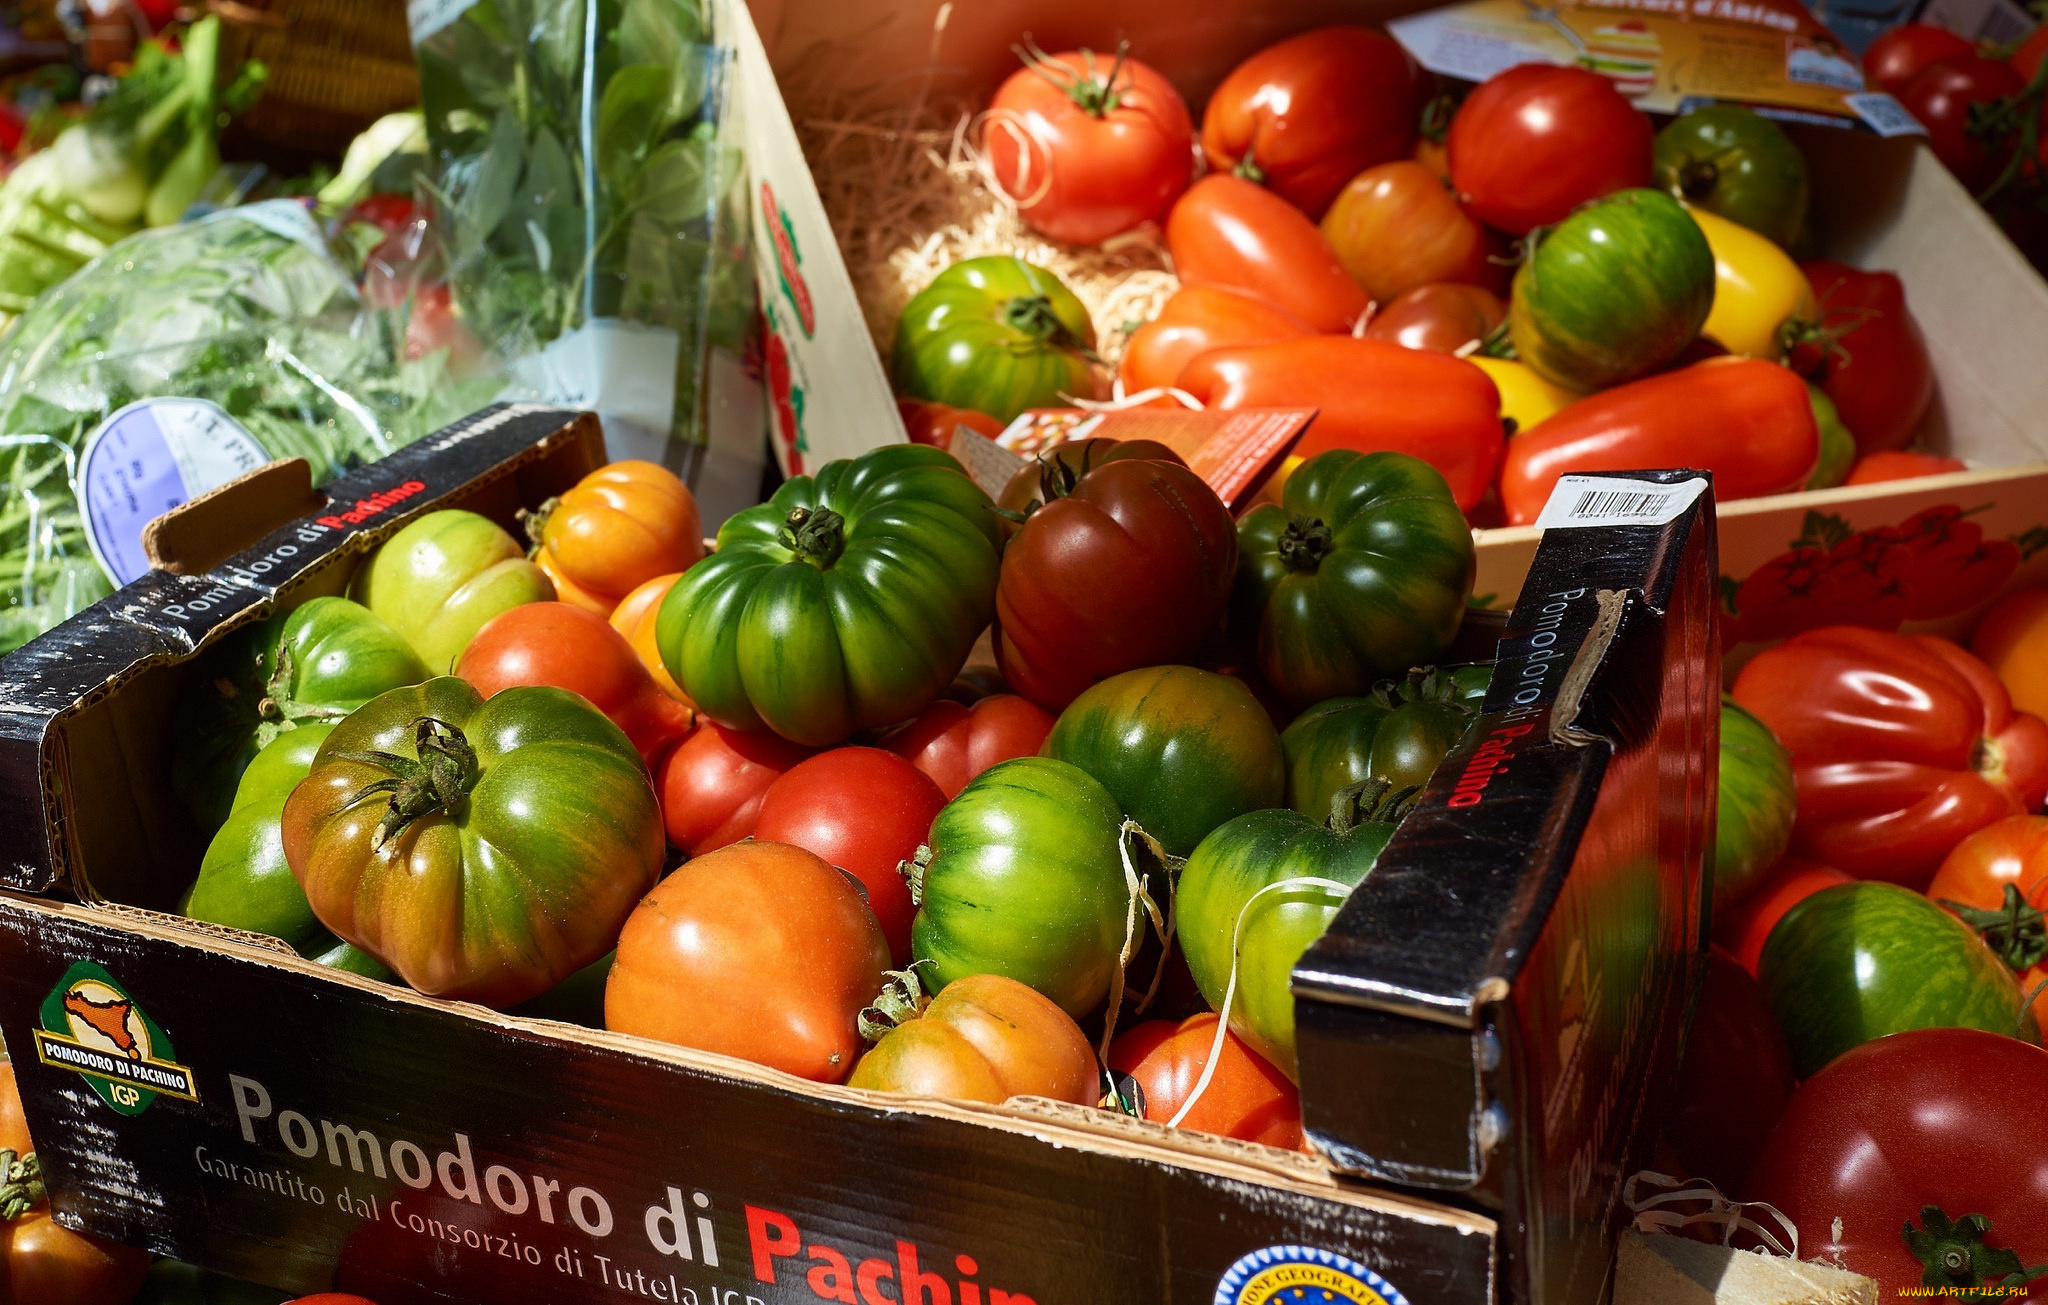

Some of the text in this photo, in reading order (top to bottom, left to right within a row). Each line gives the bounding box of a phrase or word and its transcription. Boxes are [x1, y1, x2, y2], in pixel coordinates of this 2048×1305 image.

[298, 522, 329, 543] di
[316, 479, 427, 530] Pachino
[1447, 588, 1586, 807] Pomodoro di Pachino
[45, 1042, 186, 1090] POMODORO DI PACHINO
[109, 1083, 140, 1107] IGP
[196, 1145, 325, 1205] Garantito
[336, 1186, 381, 1222] dal
[391, 1200, 543, 1266] Consorzio
[554, 1246, 584, 1278] di
[594, 1254, 698, 1305] Tutela
[228, 1073, 614, 1238] Pomodoro
[645, 1186, 719, 1268] di
